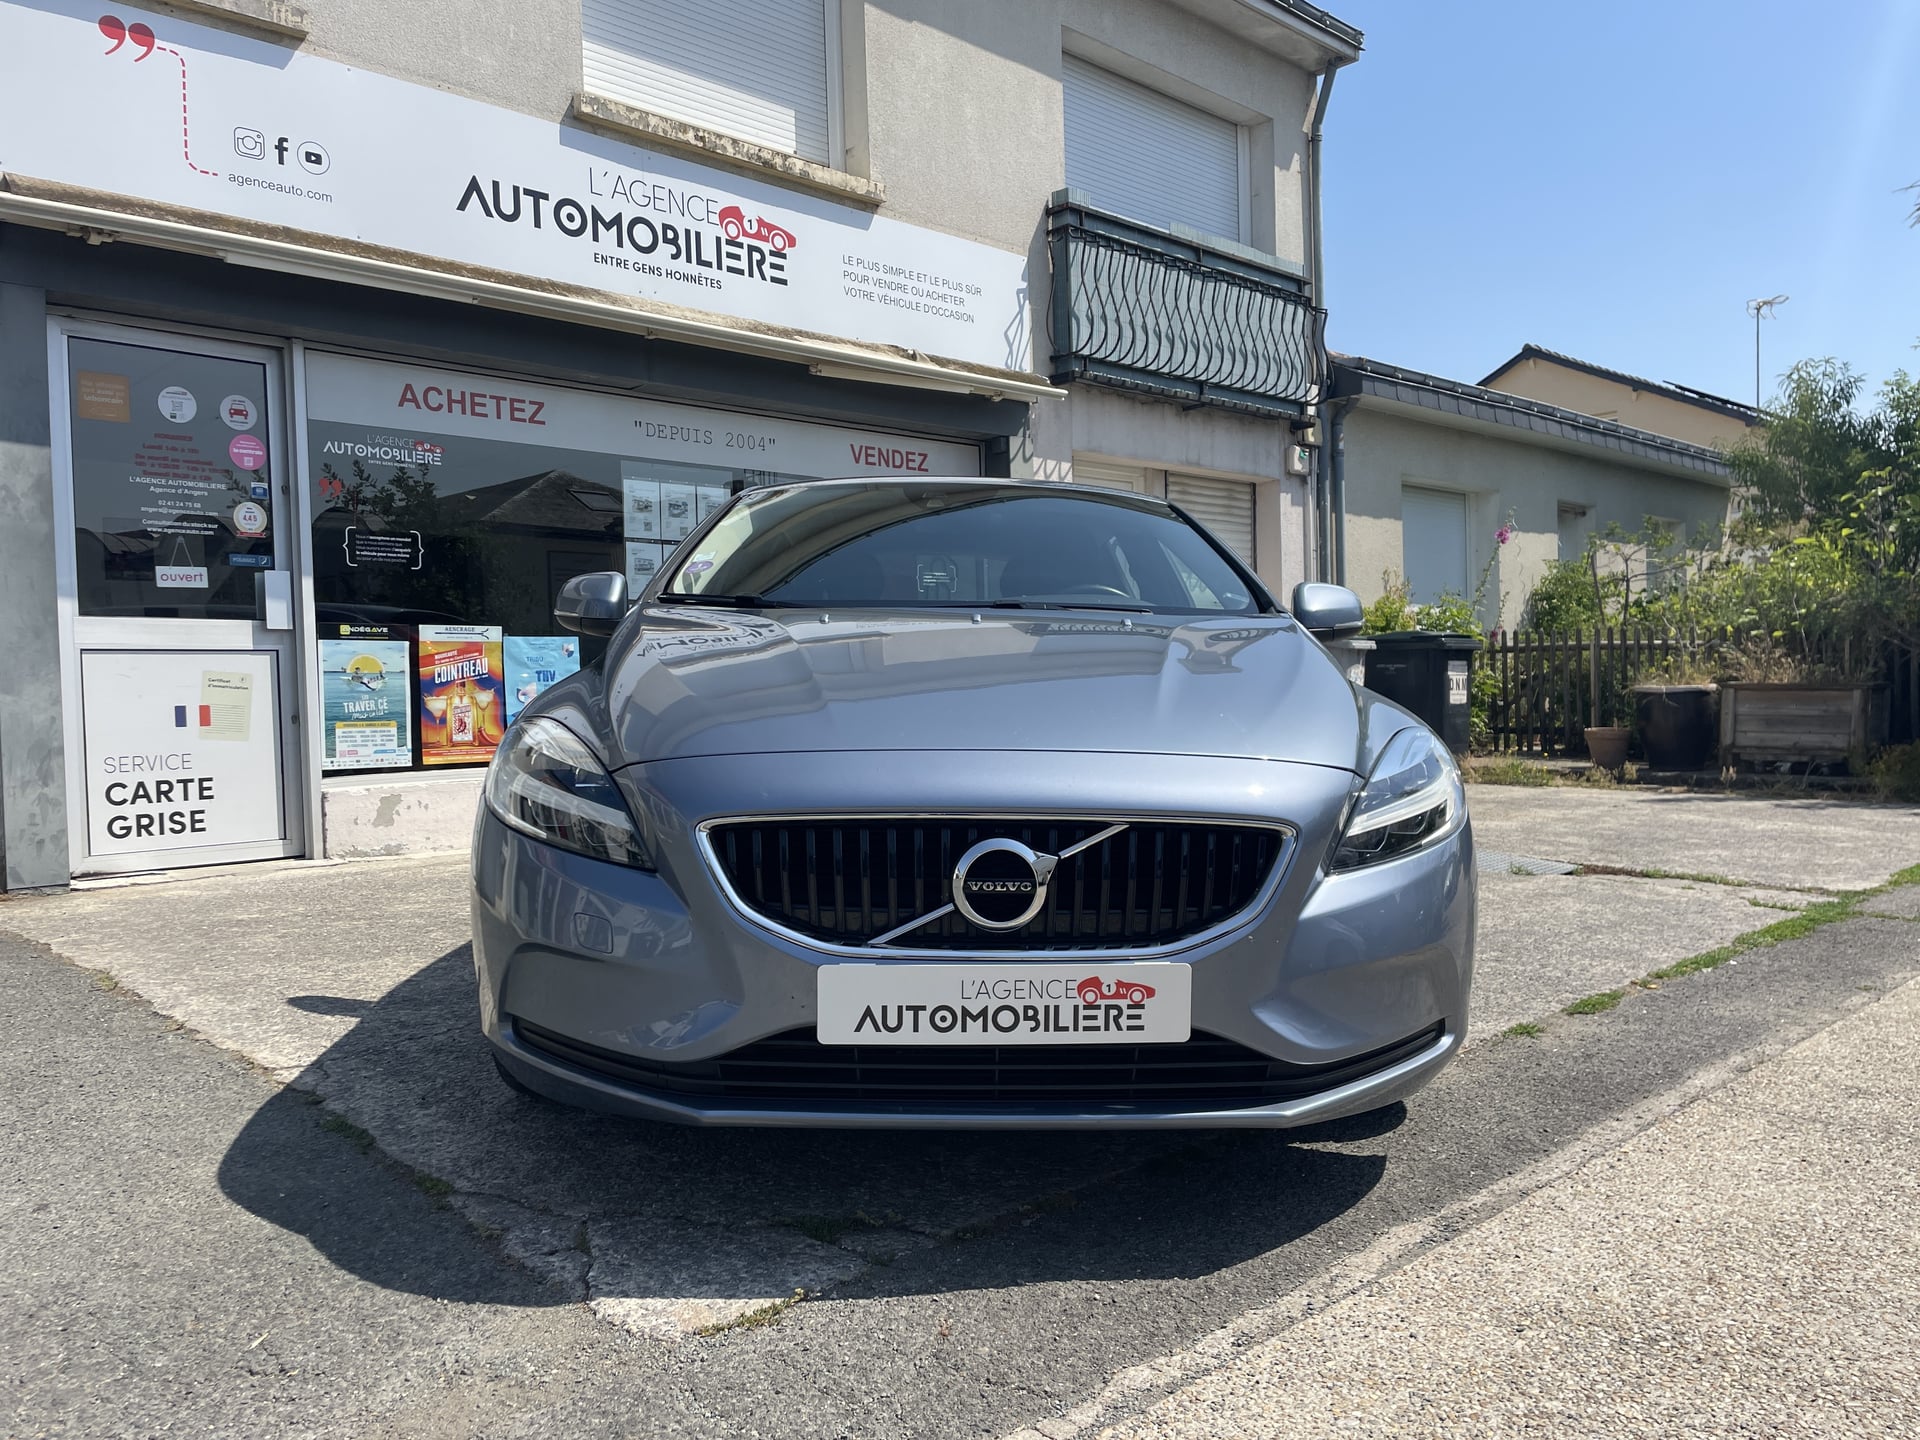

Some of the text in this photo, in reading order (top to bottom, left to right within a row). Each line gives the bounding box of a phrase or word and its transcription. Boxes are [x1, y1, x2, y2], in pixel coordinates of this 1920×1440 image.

[228, 172, 333, 203] agenceauto.com
[589, 166, 720, 226] L'AGENCE
[456, 174, 788, 287] AUTOMOBILIERE
[593, 252, 723, 290] ENTRE GENS HONNÊTES
[842, 254, 982, 297] LE PLUS SIMPLE ET LE PLUS SÛR
[843, 270, 965, 307] POUR VENDRE OU ACHETER
[843, 285, 975, 324] VOTRE VÉHICULE D'OCCASION
[398, 383, 546, 426] ACHETEZ
[323, 440, 442, 466] AUTOMOBILIERE
[365, 434, 416, 449] L'AGENCE
[849, 443, 929, 473] VENDEZ
[129, 476, 167, 486] L'AGENCE
[167, 478, 228, 490] AUTOMOBILIERE
[149, 485, 209, 497] Agence d'Angers
[160, 572, 204, 582] ouvert
[434, 657, 489, 684] COINTREAU
[103, 753, 193, 774] SERVICE
[104, 777, 215, 807] CARTE
[106, 809, 207, 840] GRISE
[966, 879, 1033, 893] VOLVO
[960, 978, 1078, 1001] L'AGENCE
[854, 1003, 1146, 1034] AUTOMOBILIERE
